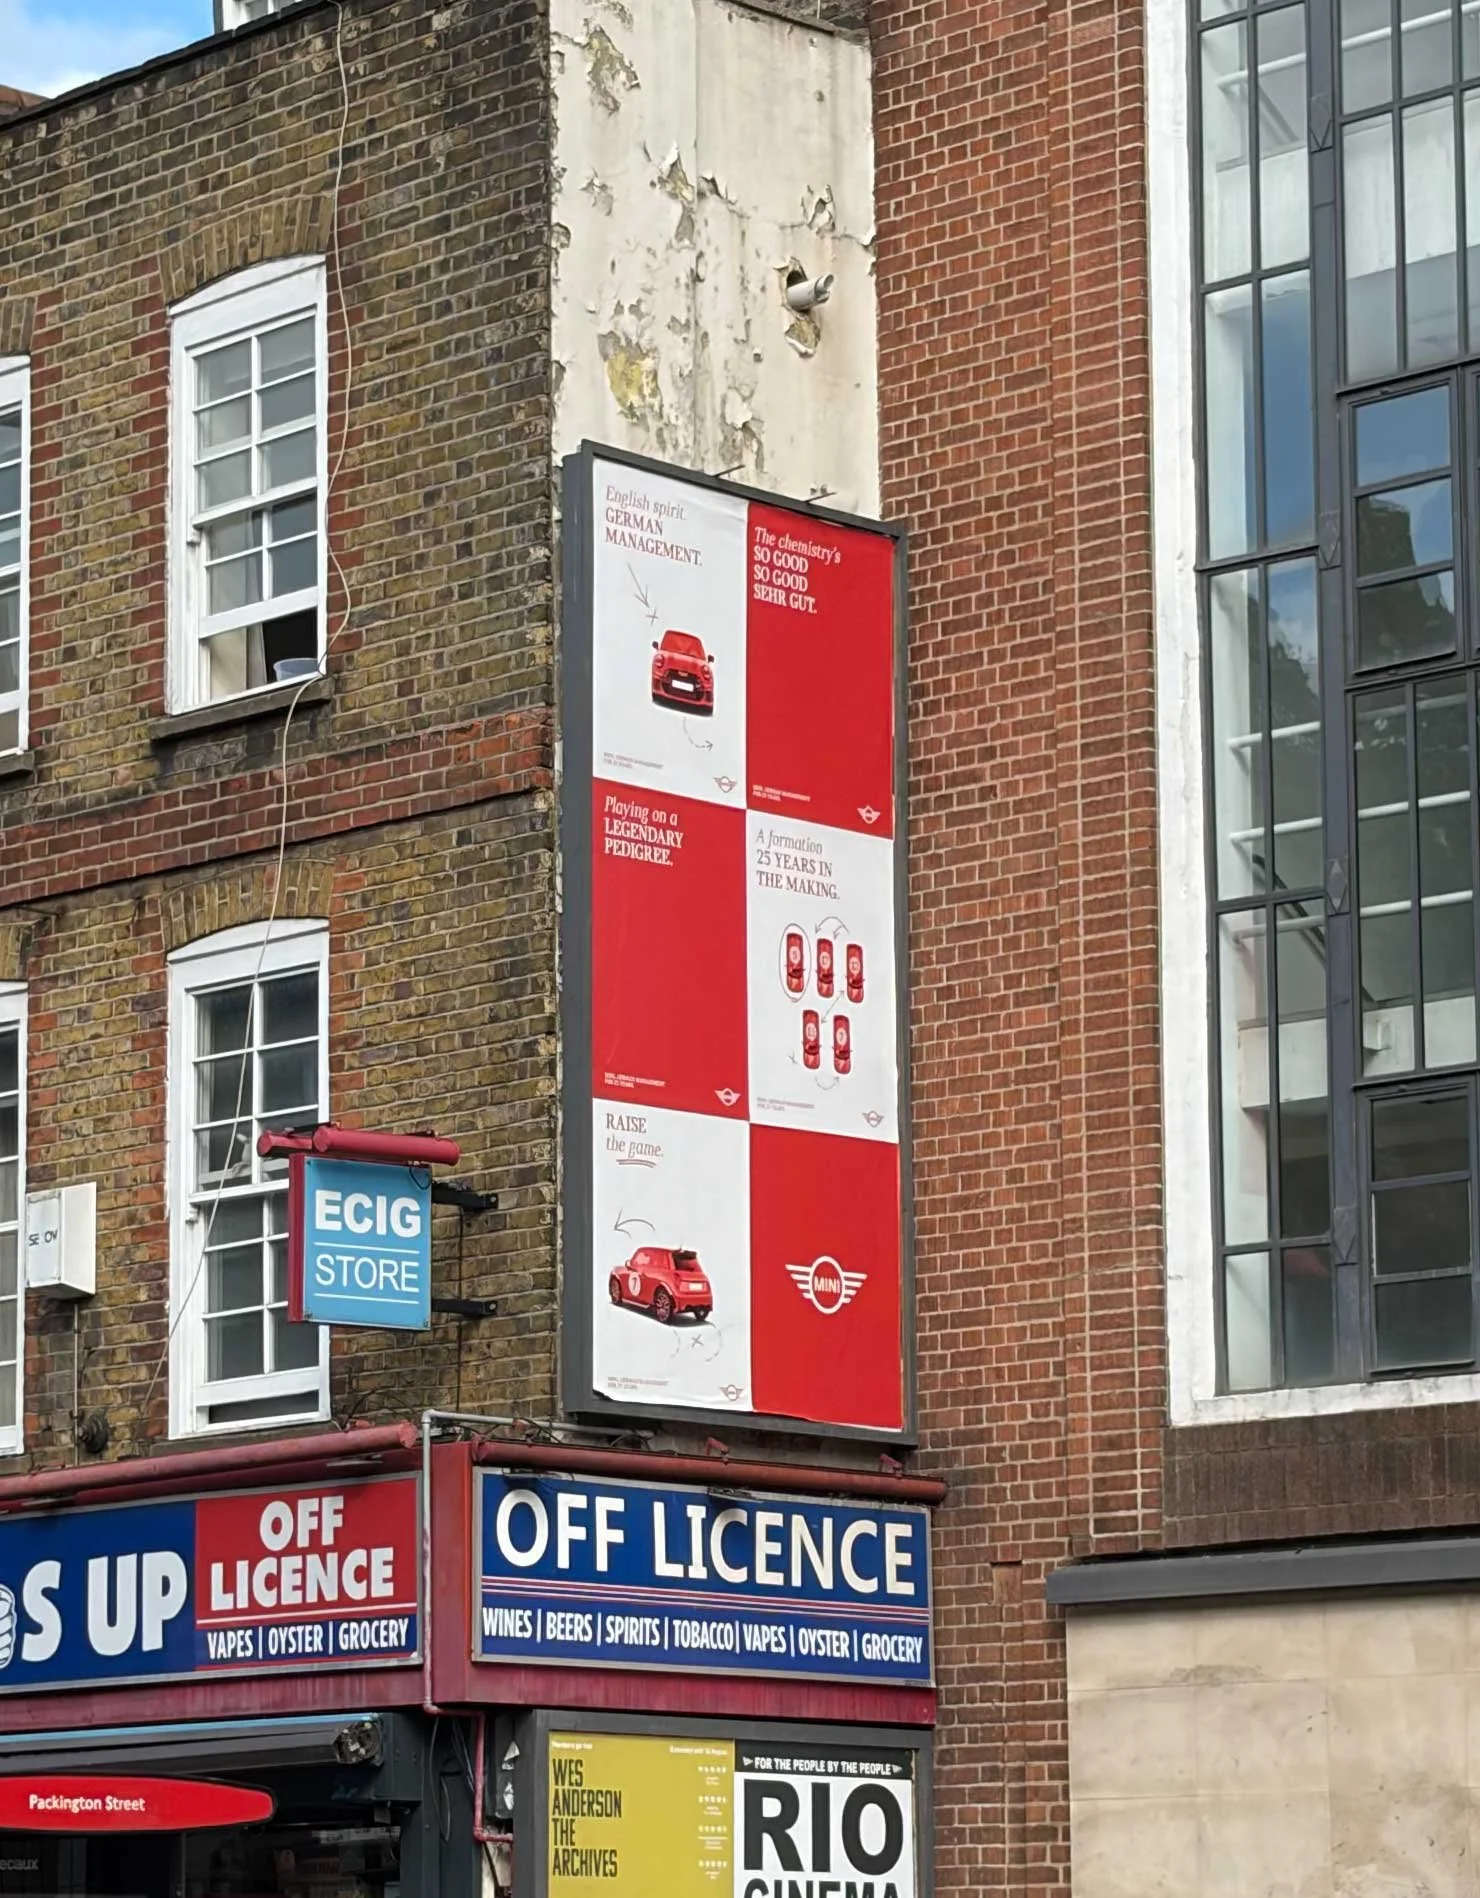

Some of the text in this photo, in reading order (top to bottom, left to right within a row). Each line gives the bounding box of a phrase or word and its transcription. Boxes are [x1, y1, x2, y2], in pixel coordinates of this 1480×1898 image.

[606, 485, 650, 511] English
[606, 506, 663, 536] GERMAN
[755, 526, 776, 546] The
[605, 526, 703, 567] MANAGEMENT.
[754, 545, 809, 573] SO GOOD
[753, 563, 808, 592] SO GOOD
[753, 582, 817, 614] SEHR GUT.
[604, 795, 678, 827] Playing on a
[604, 817, 684, 849] LEGENDARY
[756, 828, 823, 855] A formation
[604, 837, 674, 867] PEDIGREE.
[756, 848, 833, 878] 25 YEARS IN
[756, 870, 840, 900] THE MAKING.
[606, 1112, 648, 1133] RAISE
[606, 1133, 664, 1158] the game.
[315, 1189, 421, 1238] ECIG
[315, 1253, 420, 1293] STORE
[631, 1276, 638, 1291] 7
[814, 1275, 841, 1294] MINI
[259, 1495, 344, 1552] OFF
[496, 1489, 915, 1596] OFF LICENCE
[210, 1547, 394, 1611] LICENCE
[87, 1551, 188, 1656] UP
[207, 1617, 409, 1660] VAPES OYSTER GROCERY
[482, 1607, 923, 1664] WINES BEERS SPIRITS TOBACCO VAPES OYSTER GROCERY
[552, 1758, 583, 1787] WES
[754, 1757, 891, 1775] FOR THE PEOPLE BY THE PEOPLE
[29, 1794, 146, 1813] Packington Street
[552, 1788, 622, 1818] ANDERSON
[552, 1818, 576, 1846] THE
[744, 1779, 904, 1876] RIO
[552, 1848, 618, 1877] ARCHIVES
